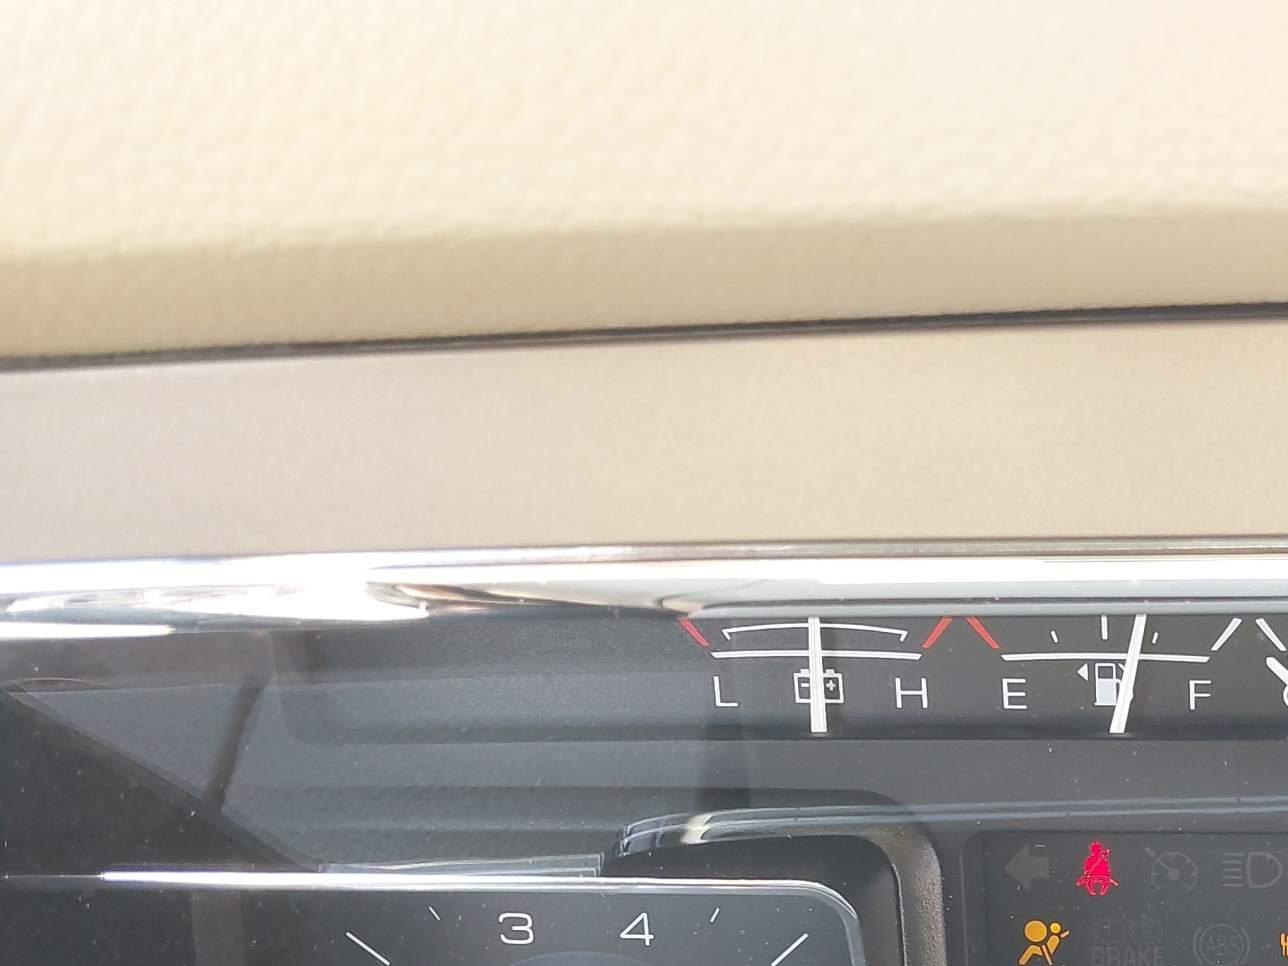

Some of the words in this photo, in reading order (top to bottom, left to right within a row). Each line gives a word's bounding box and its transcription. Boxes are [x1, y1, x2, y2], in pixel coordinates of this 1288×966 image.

[713, 676, 738, 708] L
[895, 677, 928, 709] H
[1002, 677, 1028, 710] E
[1189, 679, 1212, 711] F
[498, 912, 535, 946] 3
[619, 912, 655, 946] 4
